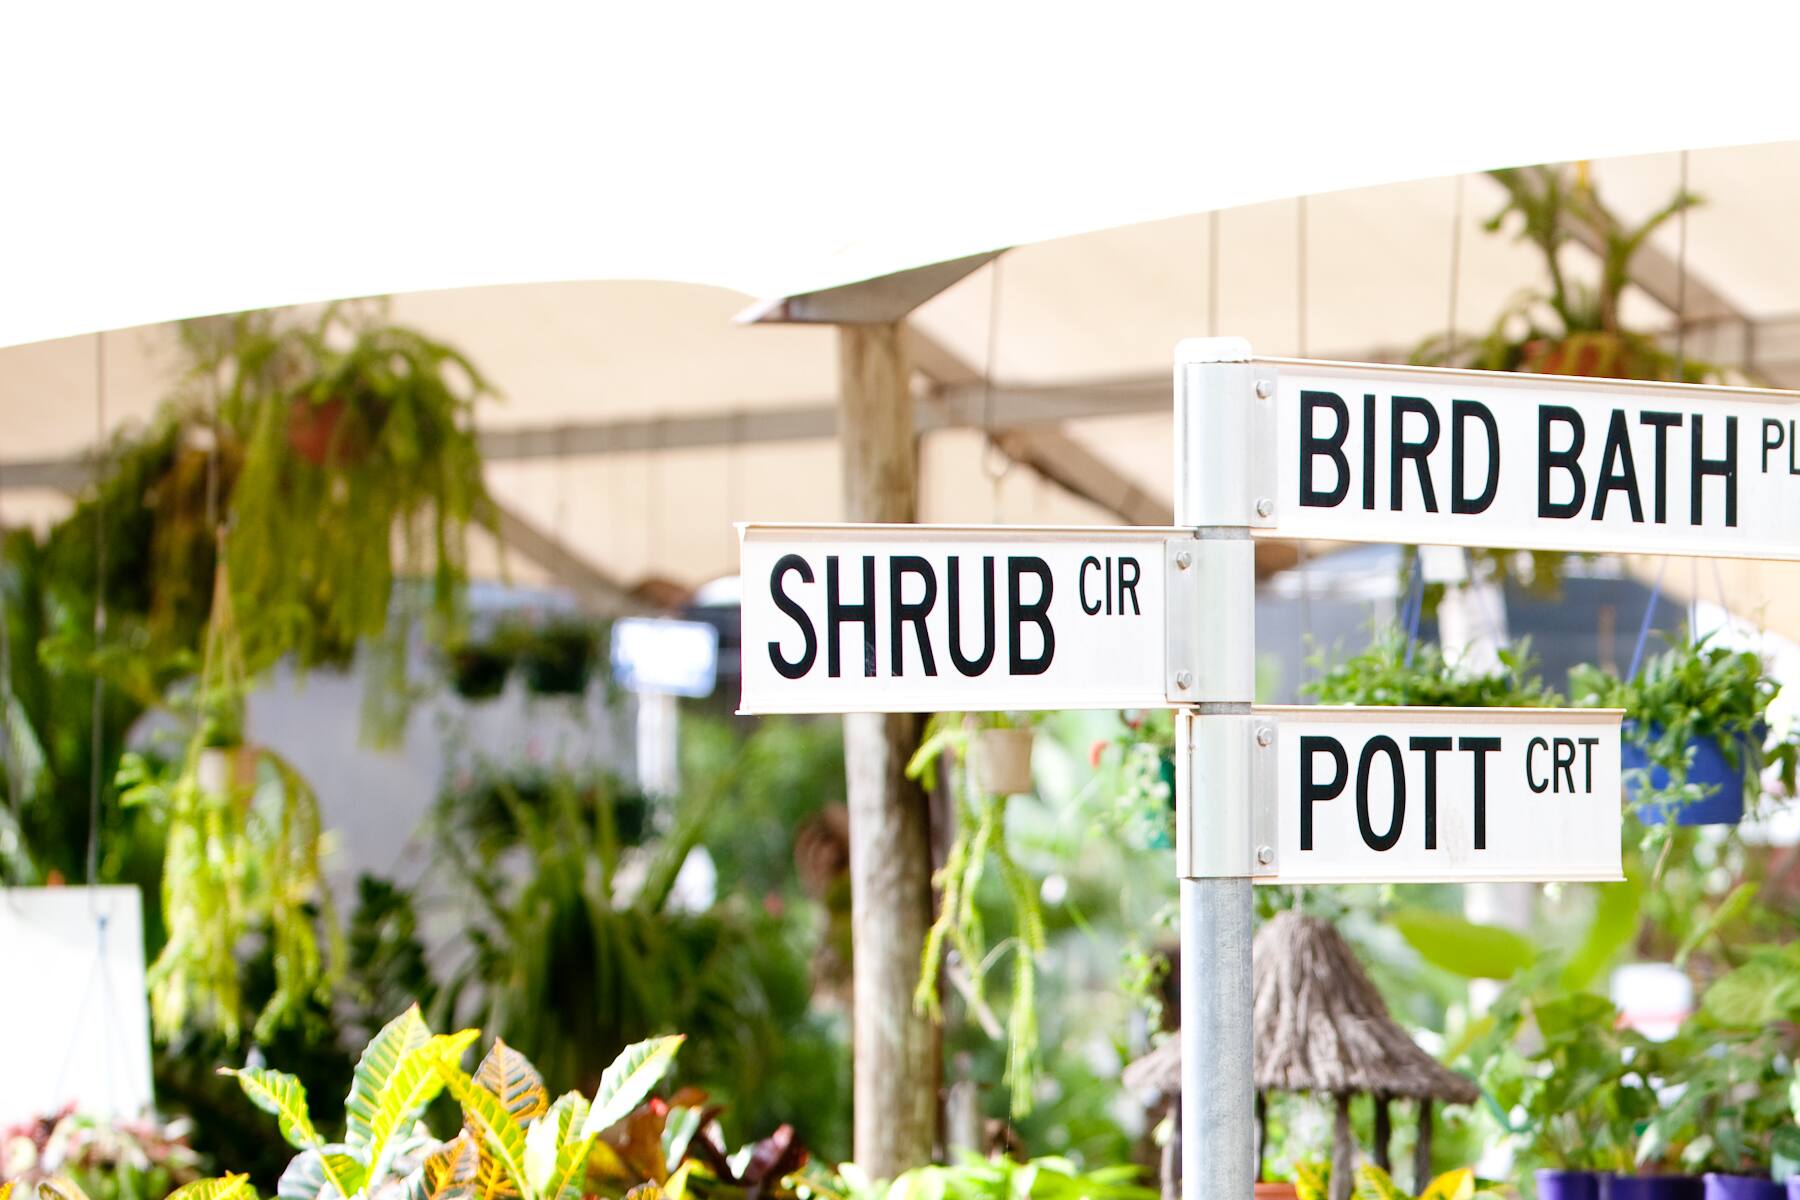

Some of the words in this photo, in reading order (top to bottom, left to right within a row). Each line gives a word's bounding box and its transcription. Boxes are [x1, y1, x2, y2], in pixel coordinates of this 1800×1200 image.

[1299, 390, 1501, 516] BIRD
[1537, 404, 1739, 529] BATH
[768, 554, 1057, 680] SHRUB
[1078, 555, 1142, 617] CIR
[1300, 734, 1503, 852] POTT
[1525, 736, 1600, 795] CRT
